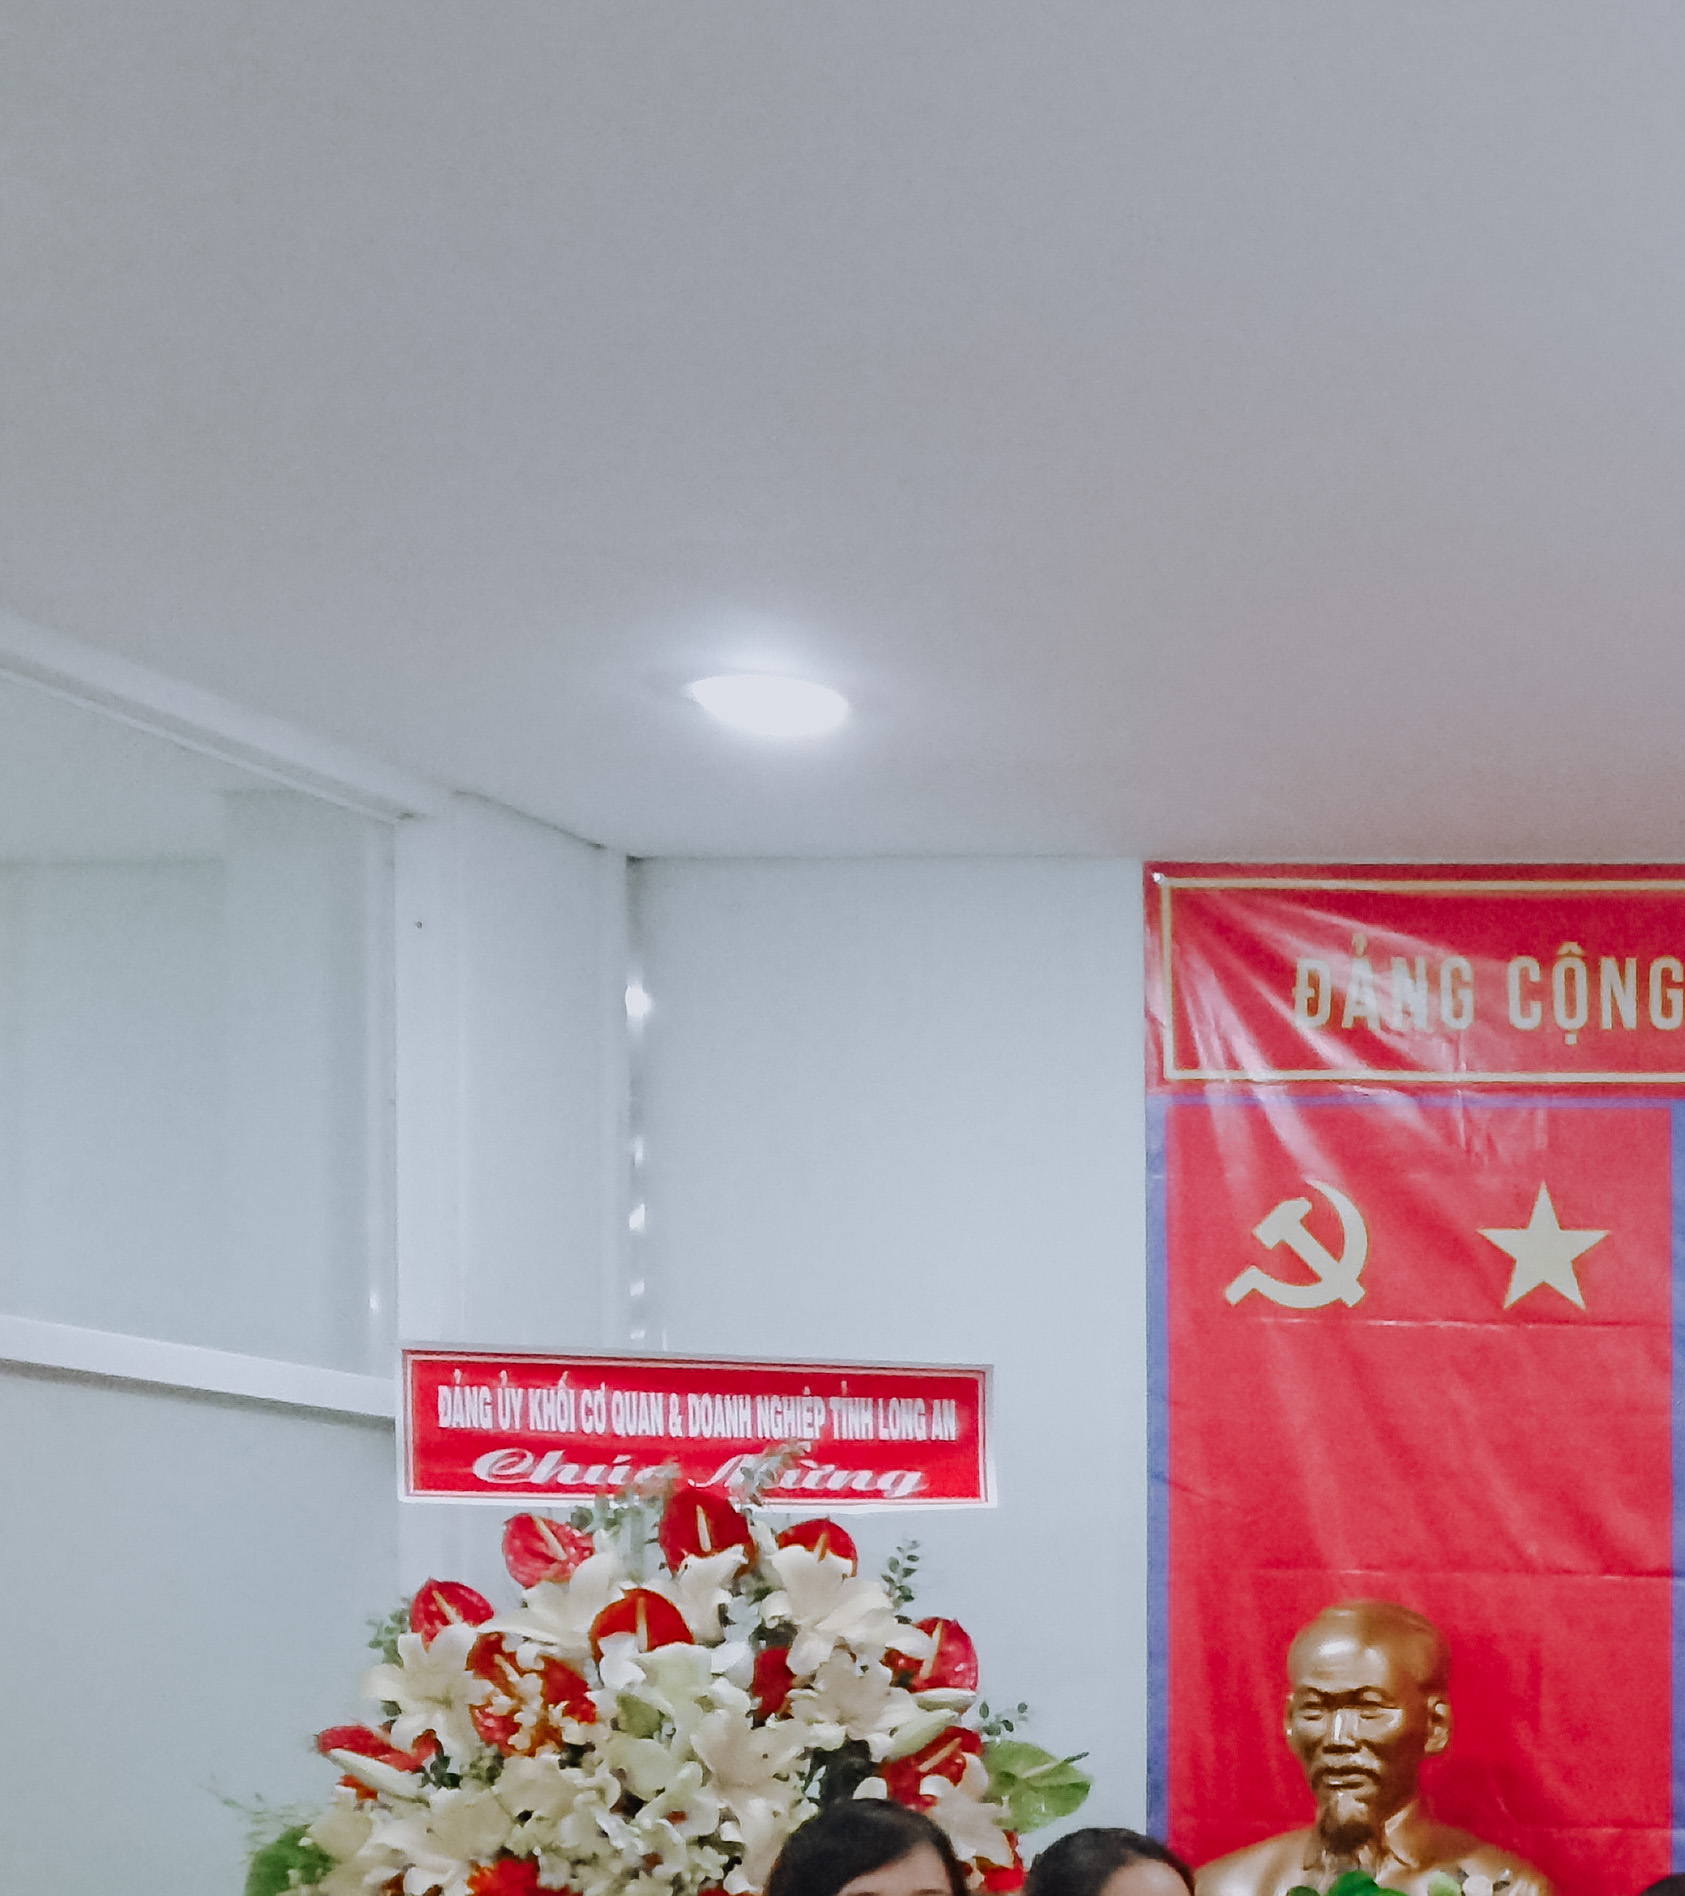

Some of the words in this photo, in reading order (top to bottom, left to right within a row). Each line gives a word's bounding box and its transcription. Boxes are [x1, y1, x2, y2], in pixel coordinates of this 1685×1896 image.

[1292, 933, 1475, 1029] ĐẢNG
[1508, 941, 1685, 1046] CỘNG
[612, 1391, 664, 1437] QUAN
[669, 1393, 683, 1437] &
[688, 1392, 750, 1438] DOANH
[878, 1398, 926, 1440] LONG
[932, 1399, 956, 1441] AN
